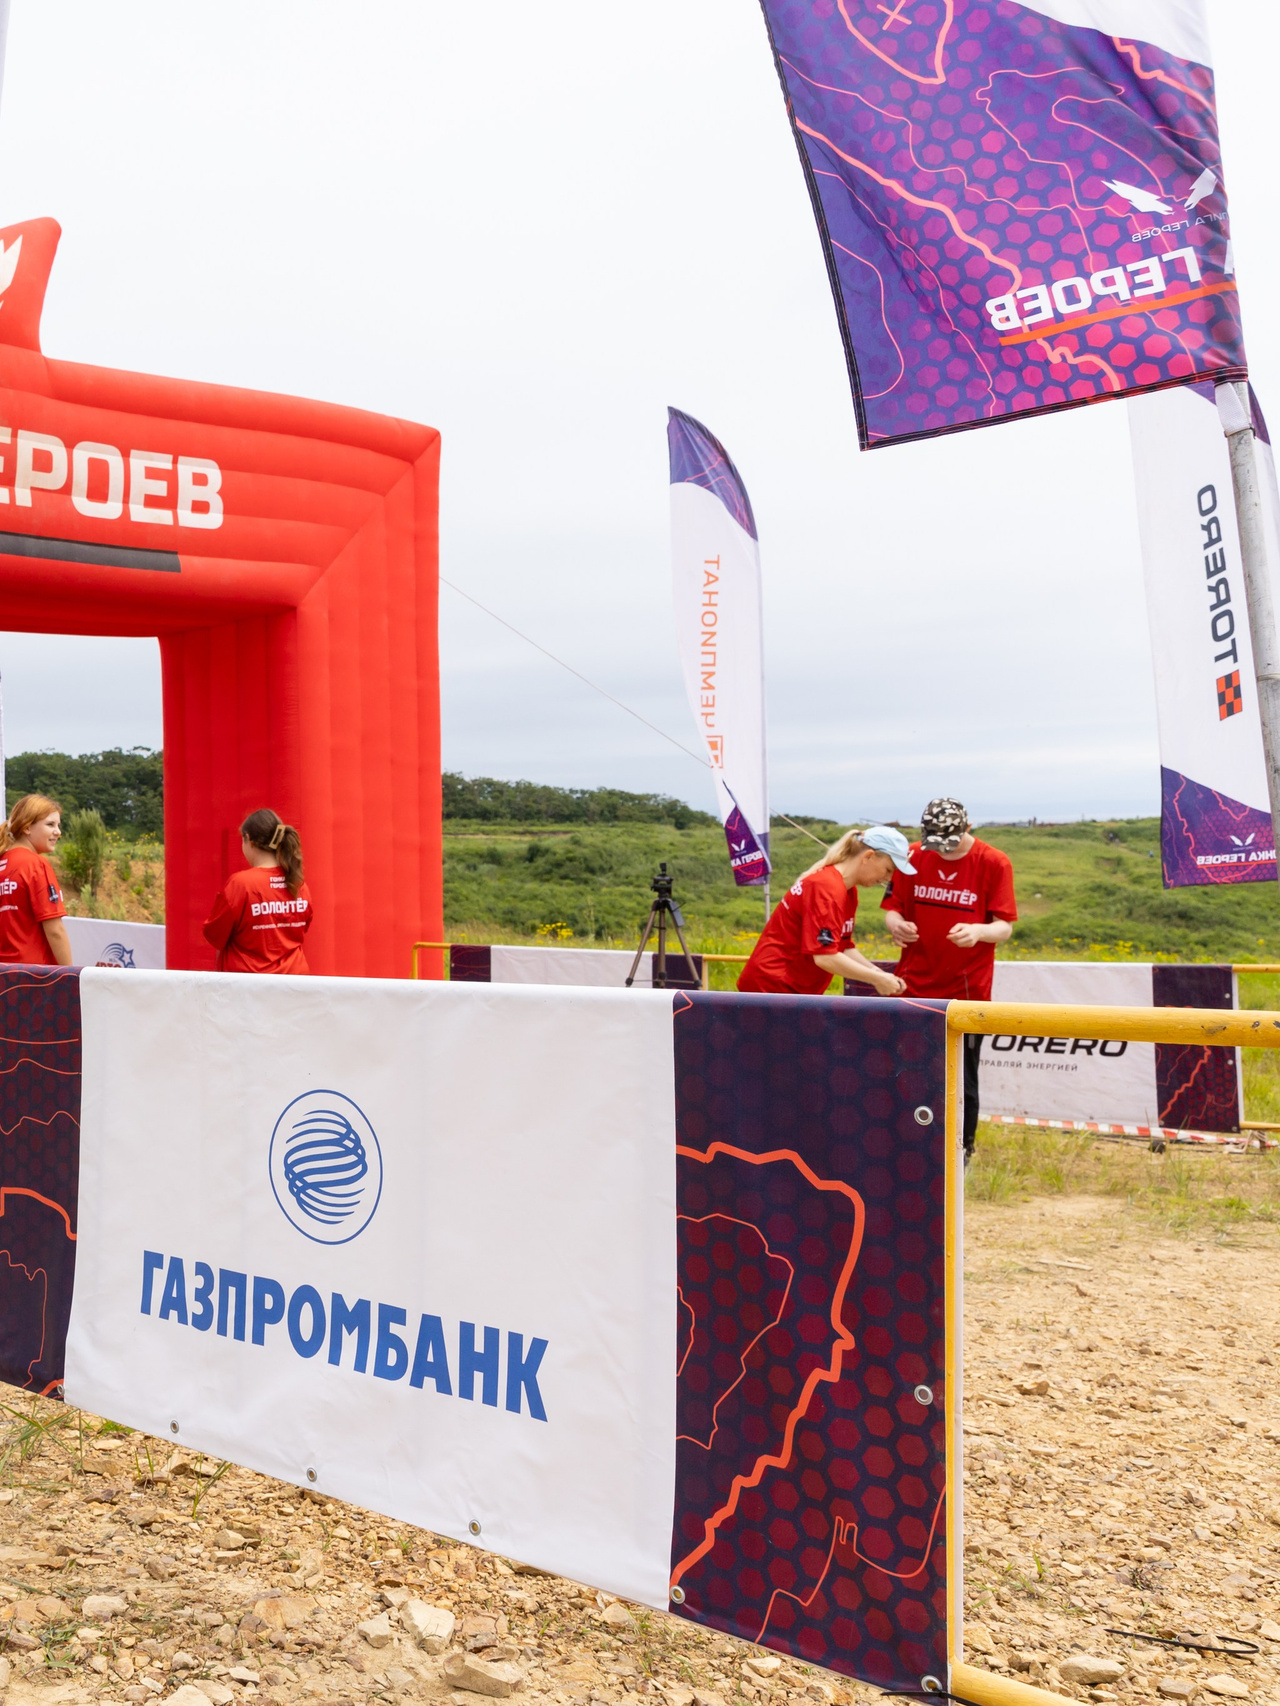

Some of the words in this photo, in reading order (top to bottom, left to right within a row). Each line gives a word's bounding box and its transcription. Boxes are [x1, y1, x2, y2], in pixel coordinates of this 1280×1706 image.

[251, 897, 308, 917] ВОЛОНТЁР
[978, 1059, 1023, 1069] ПРАВЛЯЙ
[1026, 1062, 1078, 1072] ЭНЕРГИЕЙ
[140, 1250, 549, 1423] ГАЗПРОМБАНК
